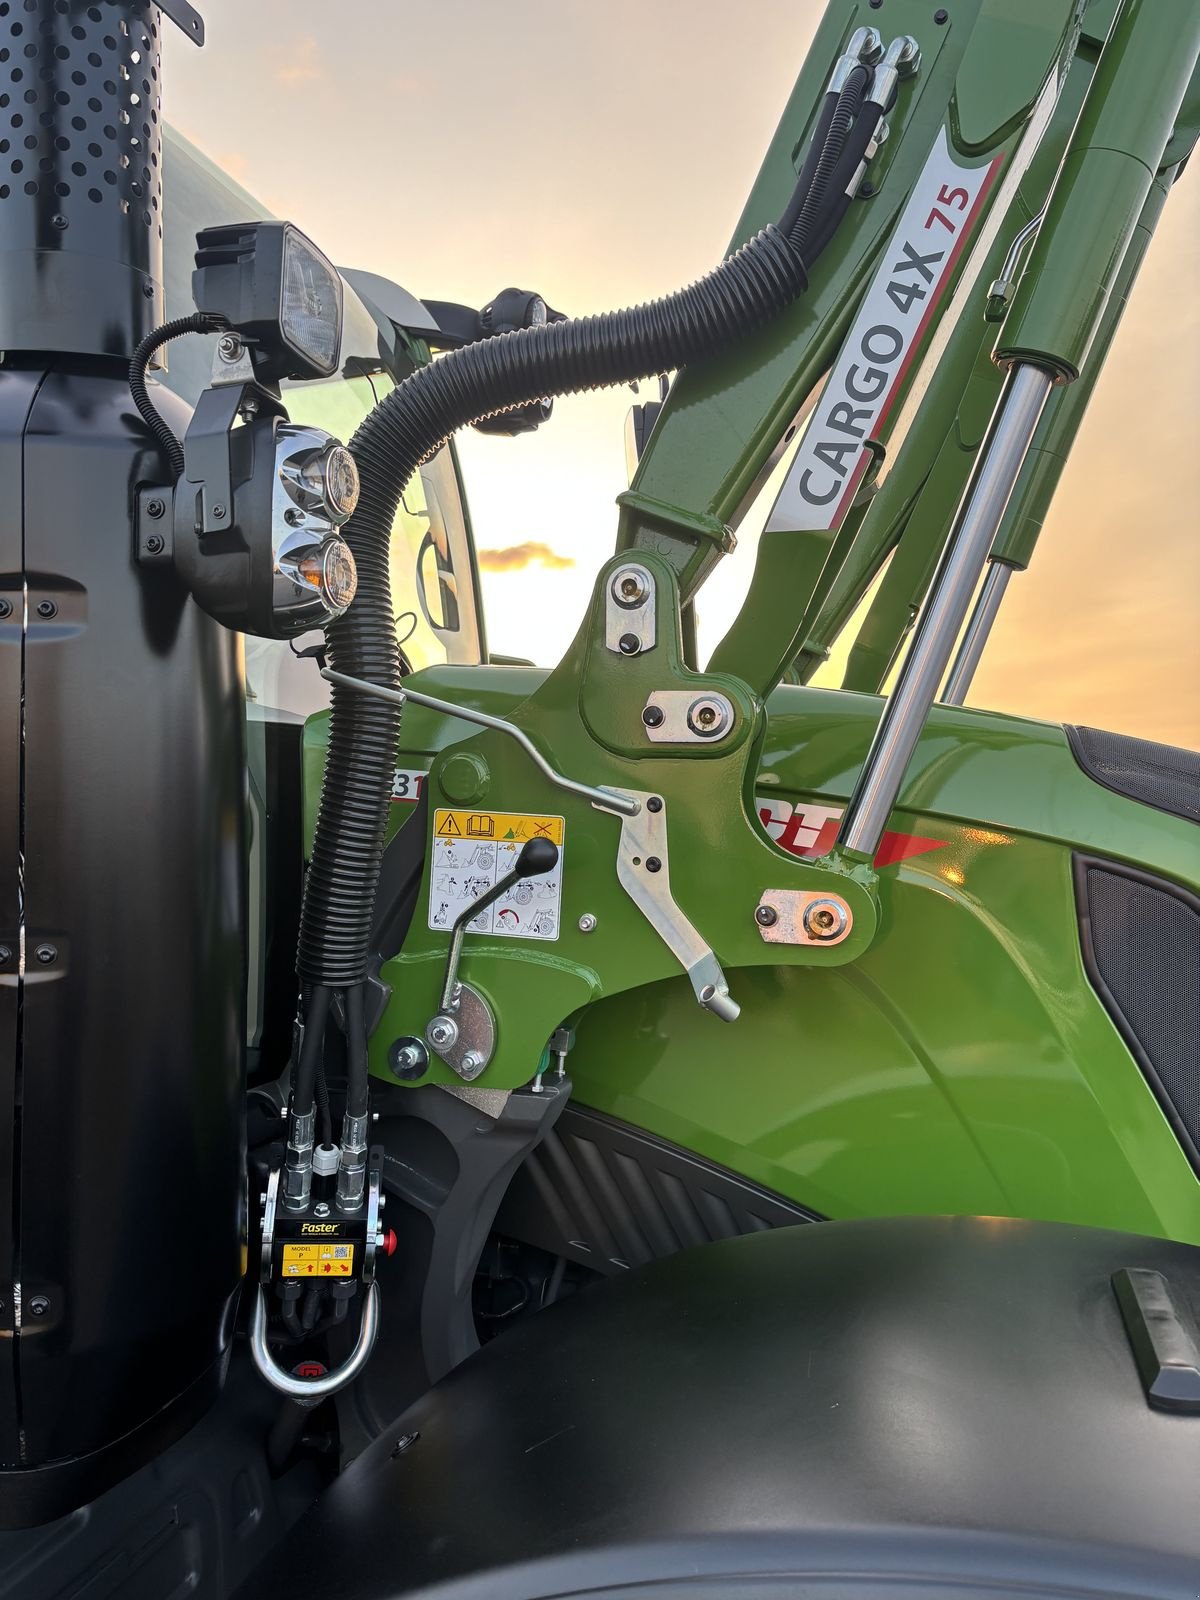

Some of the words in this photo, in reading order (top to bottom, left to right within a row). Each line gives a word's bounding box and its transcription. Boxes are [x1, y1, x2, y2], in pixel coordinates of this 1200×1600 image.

[800, 325, 903, 505] CARGO
[886, 241, 944, 314] 4X
[925, 184, 969, 235] 75
[301, 1223, 339, 1233] Faster
